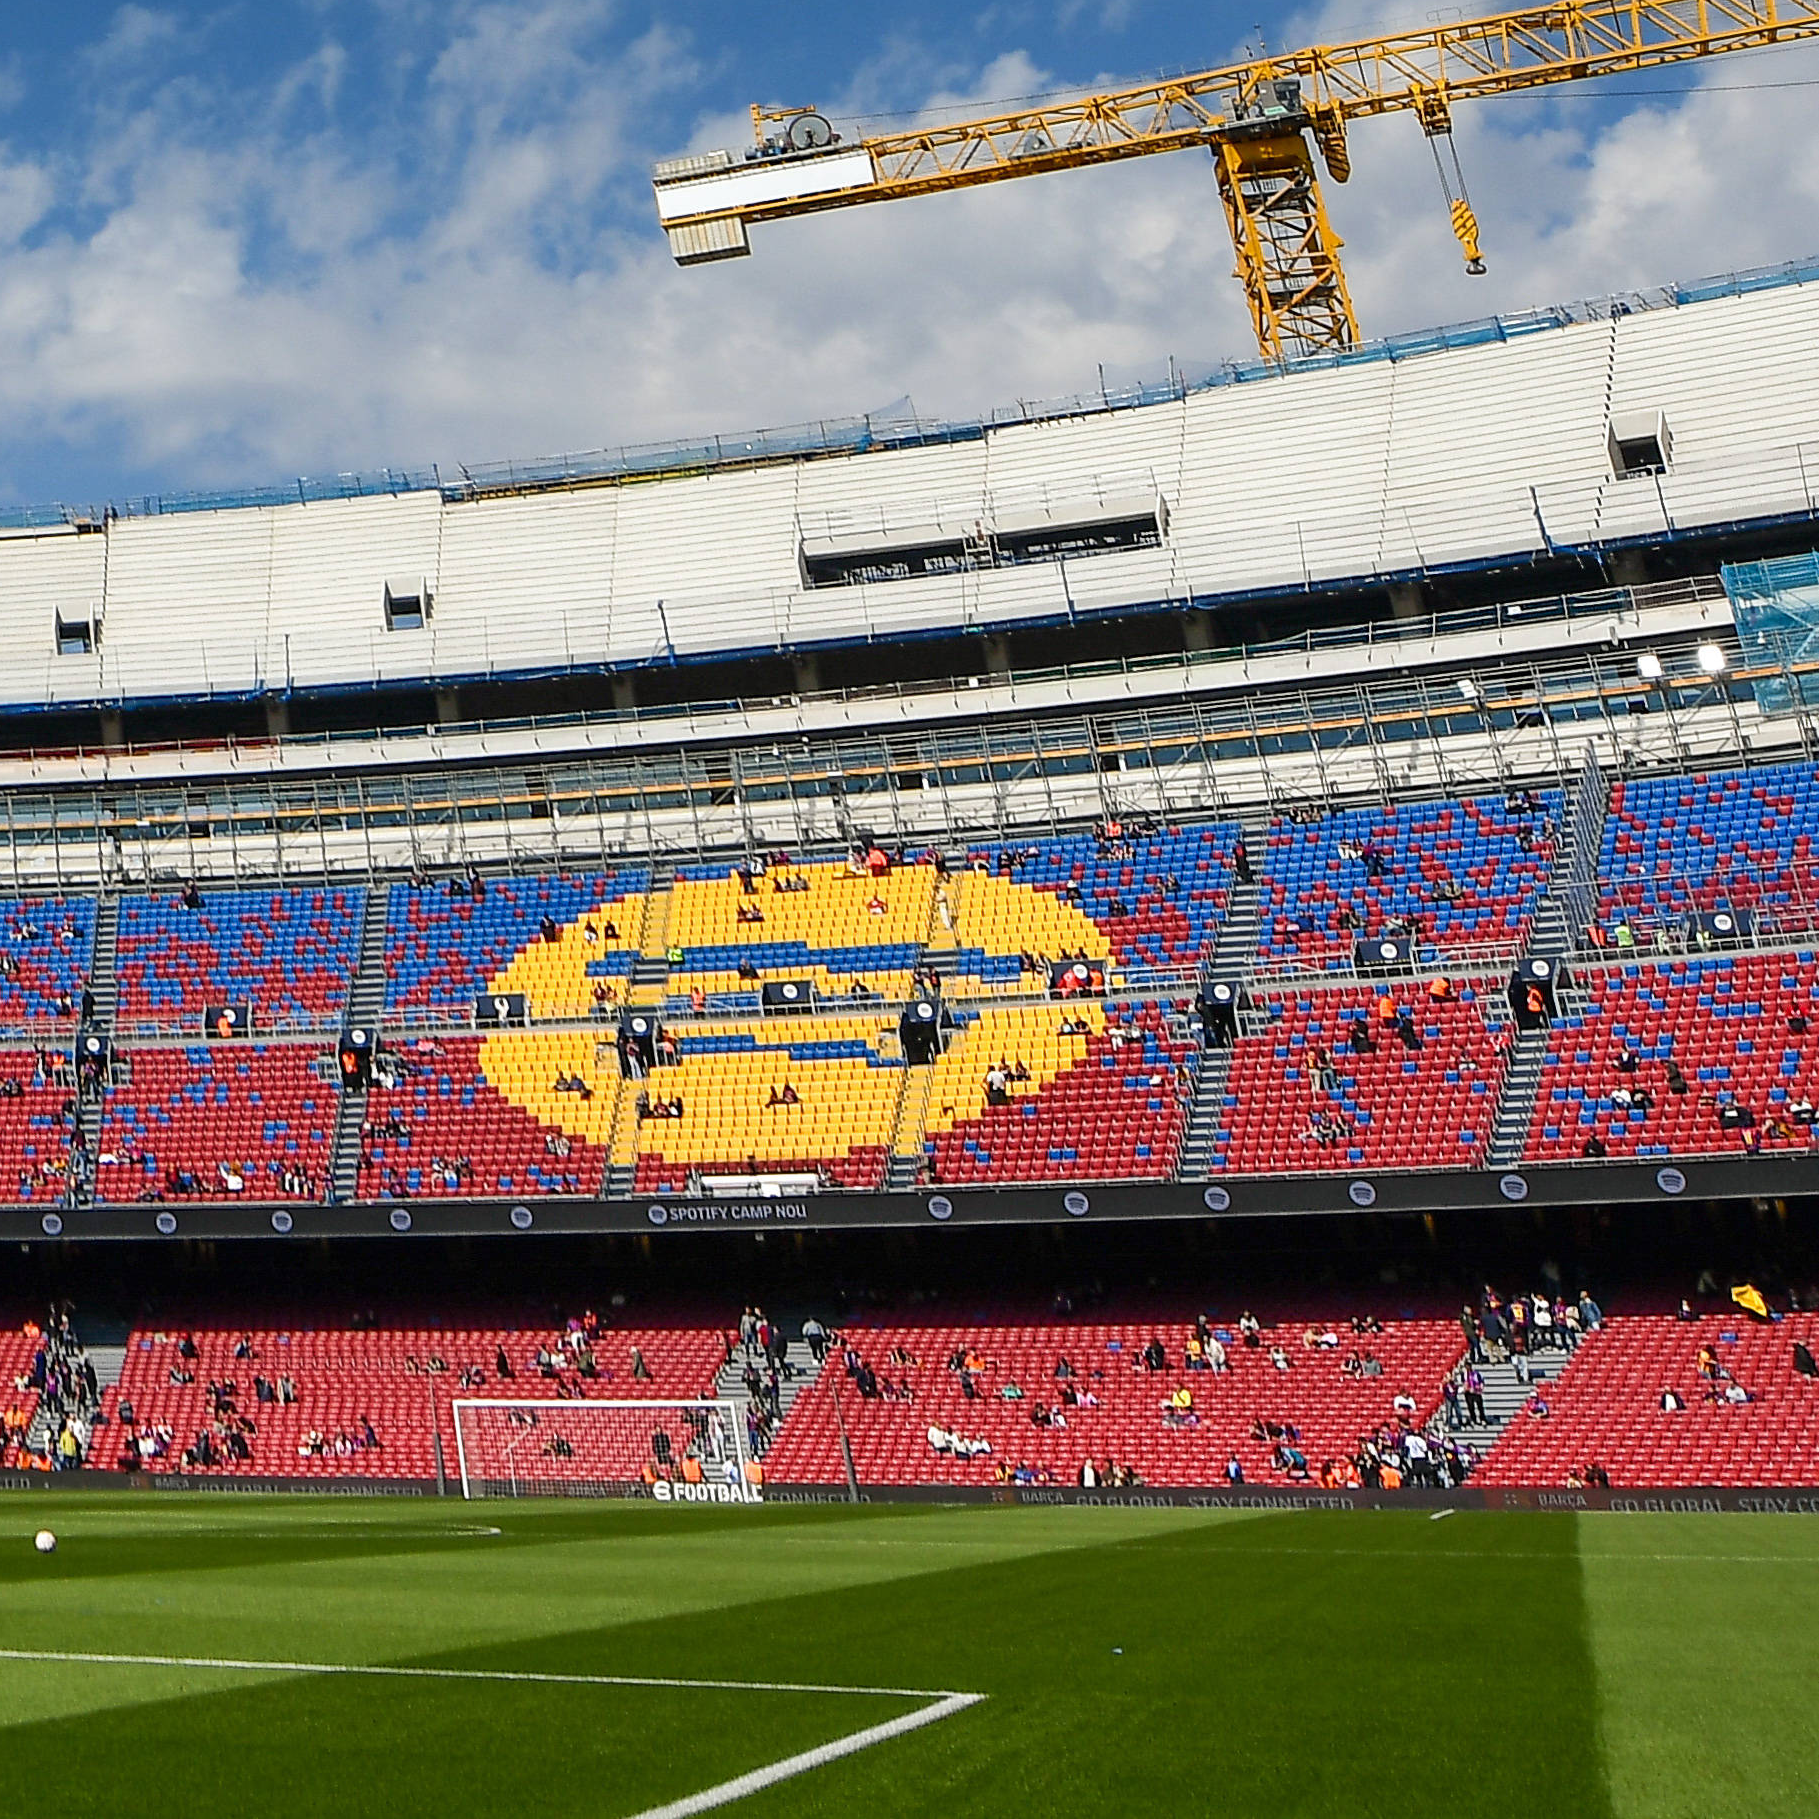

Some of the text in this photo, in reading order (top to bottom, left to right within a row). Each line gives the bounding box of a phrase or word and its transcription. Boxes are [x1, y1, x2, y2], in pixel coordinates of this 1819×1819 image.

[670, 1204, 807, 1221] SPOTIFY CAMP NOU
[769, 1492, 872, 1504] CONNECTD
